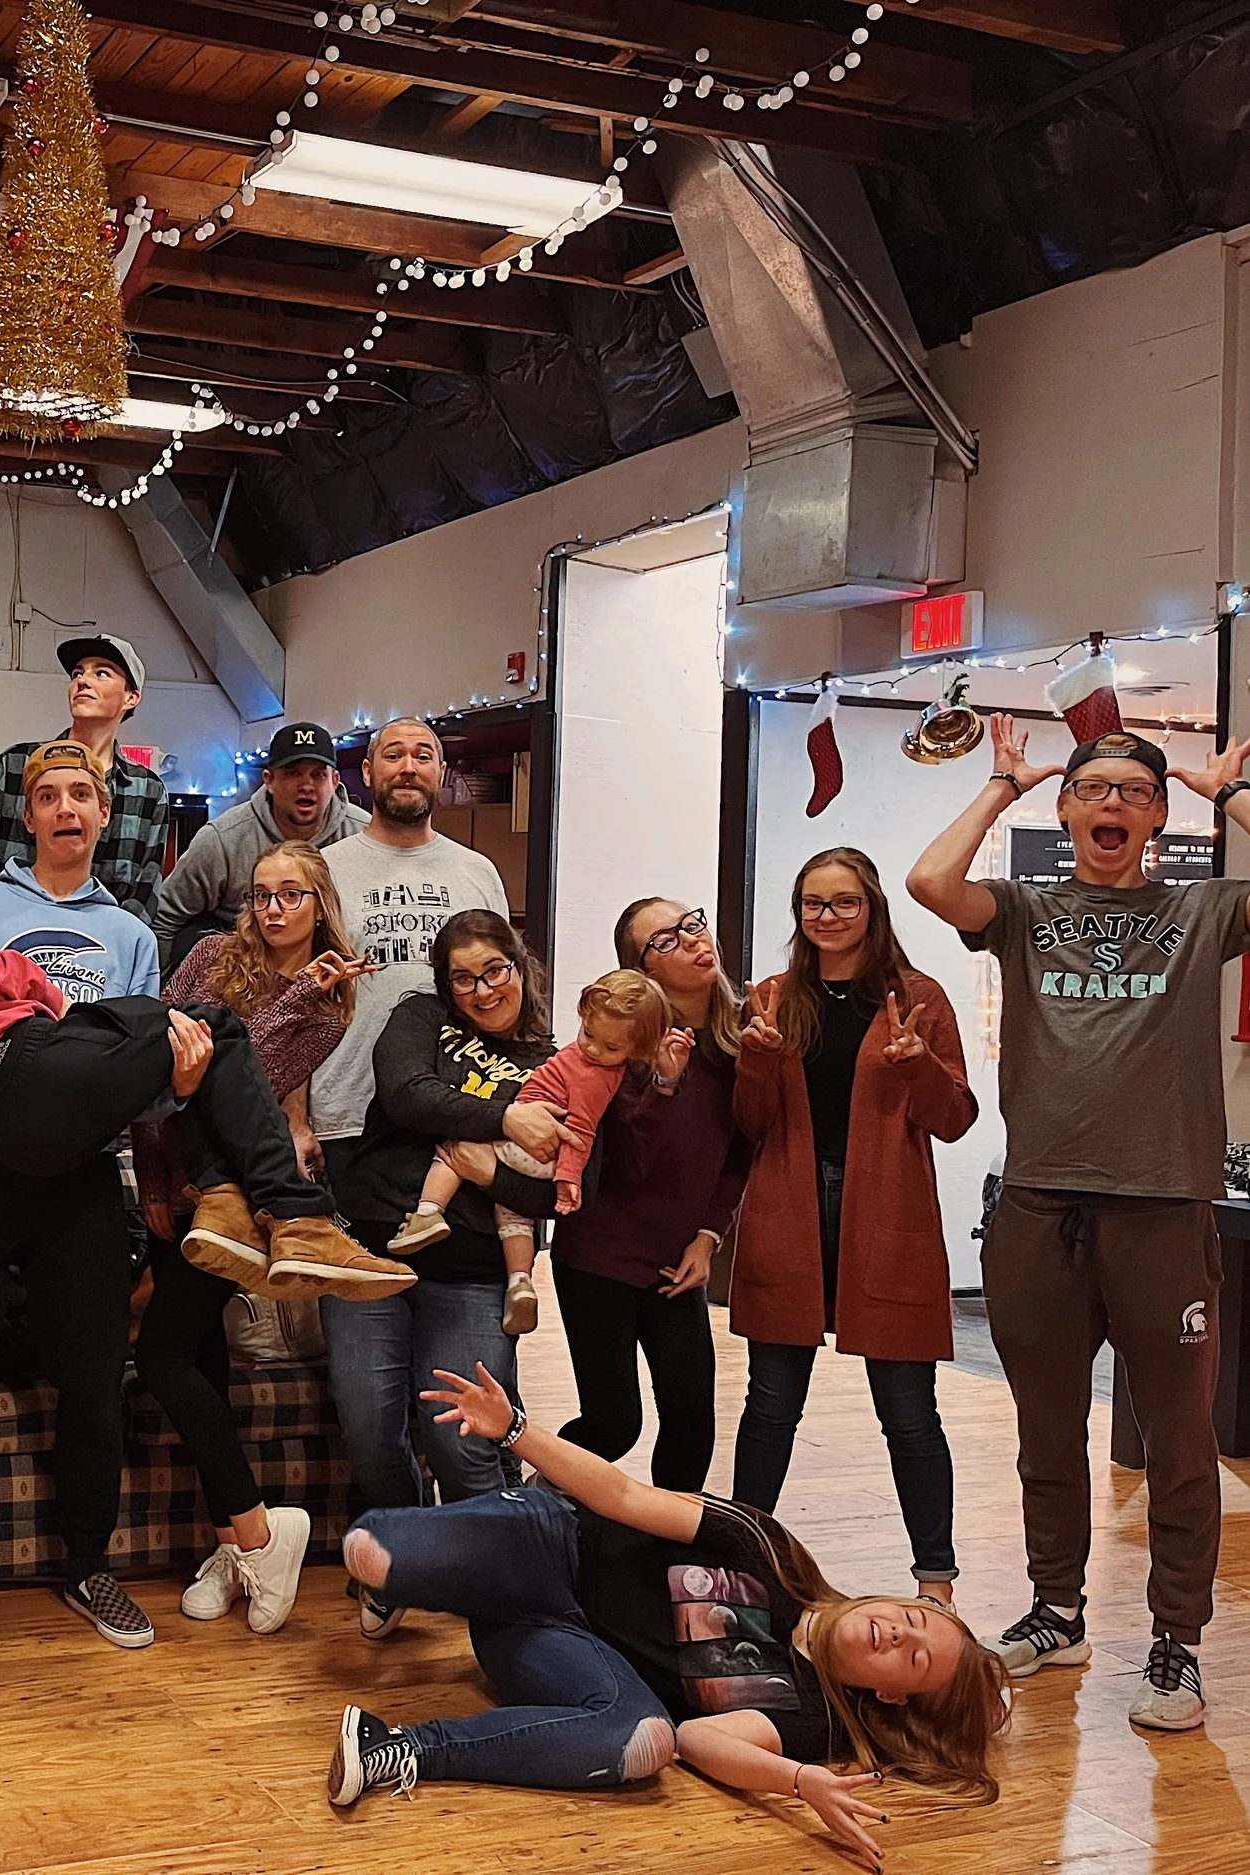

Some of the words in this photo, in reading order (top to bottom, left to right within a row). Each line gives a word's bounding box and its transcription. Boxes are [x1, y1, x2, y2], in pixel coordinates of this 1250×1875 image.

[912, 594, 966, 652] EXIT
[294, 730, 315, 745] M
[1031, 912, 1186, 957] SEATTLE
[1039, 971, 1167, 999] KRAKEN
